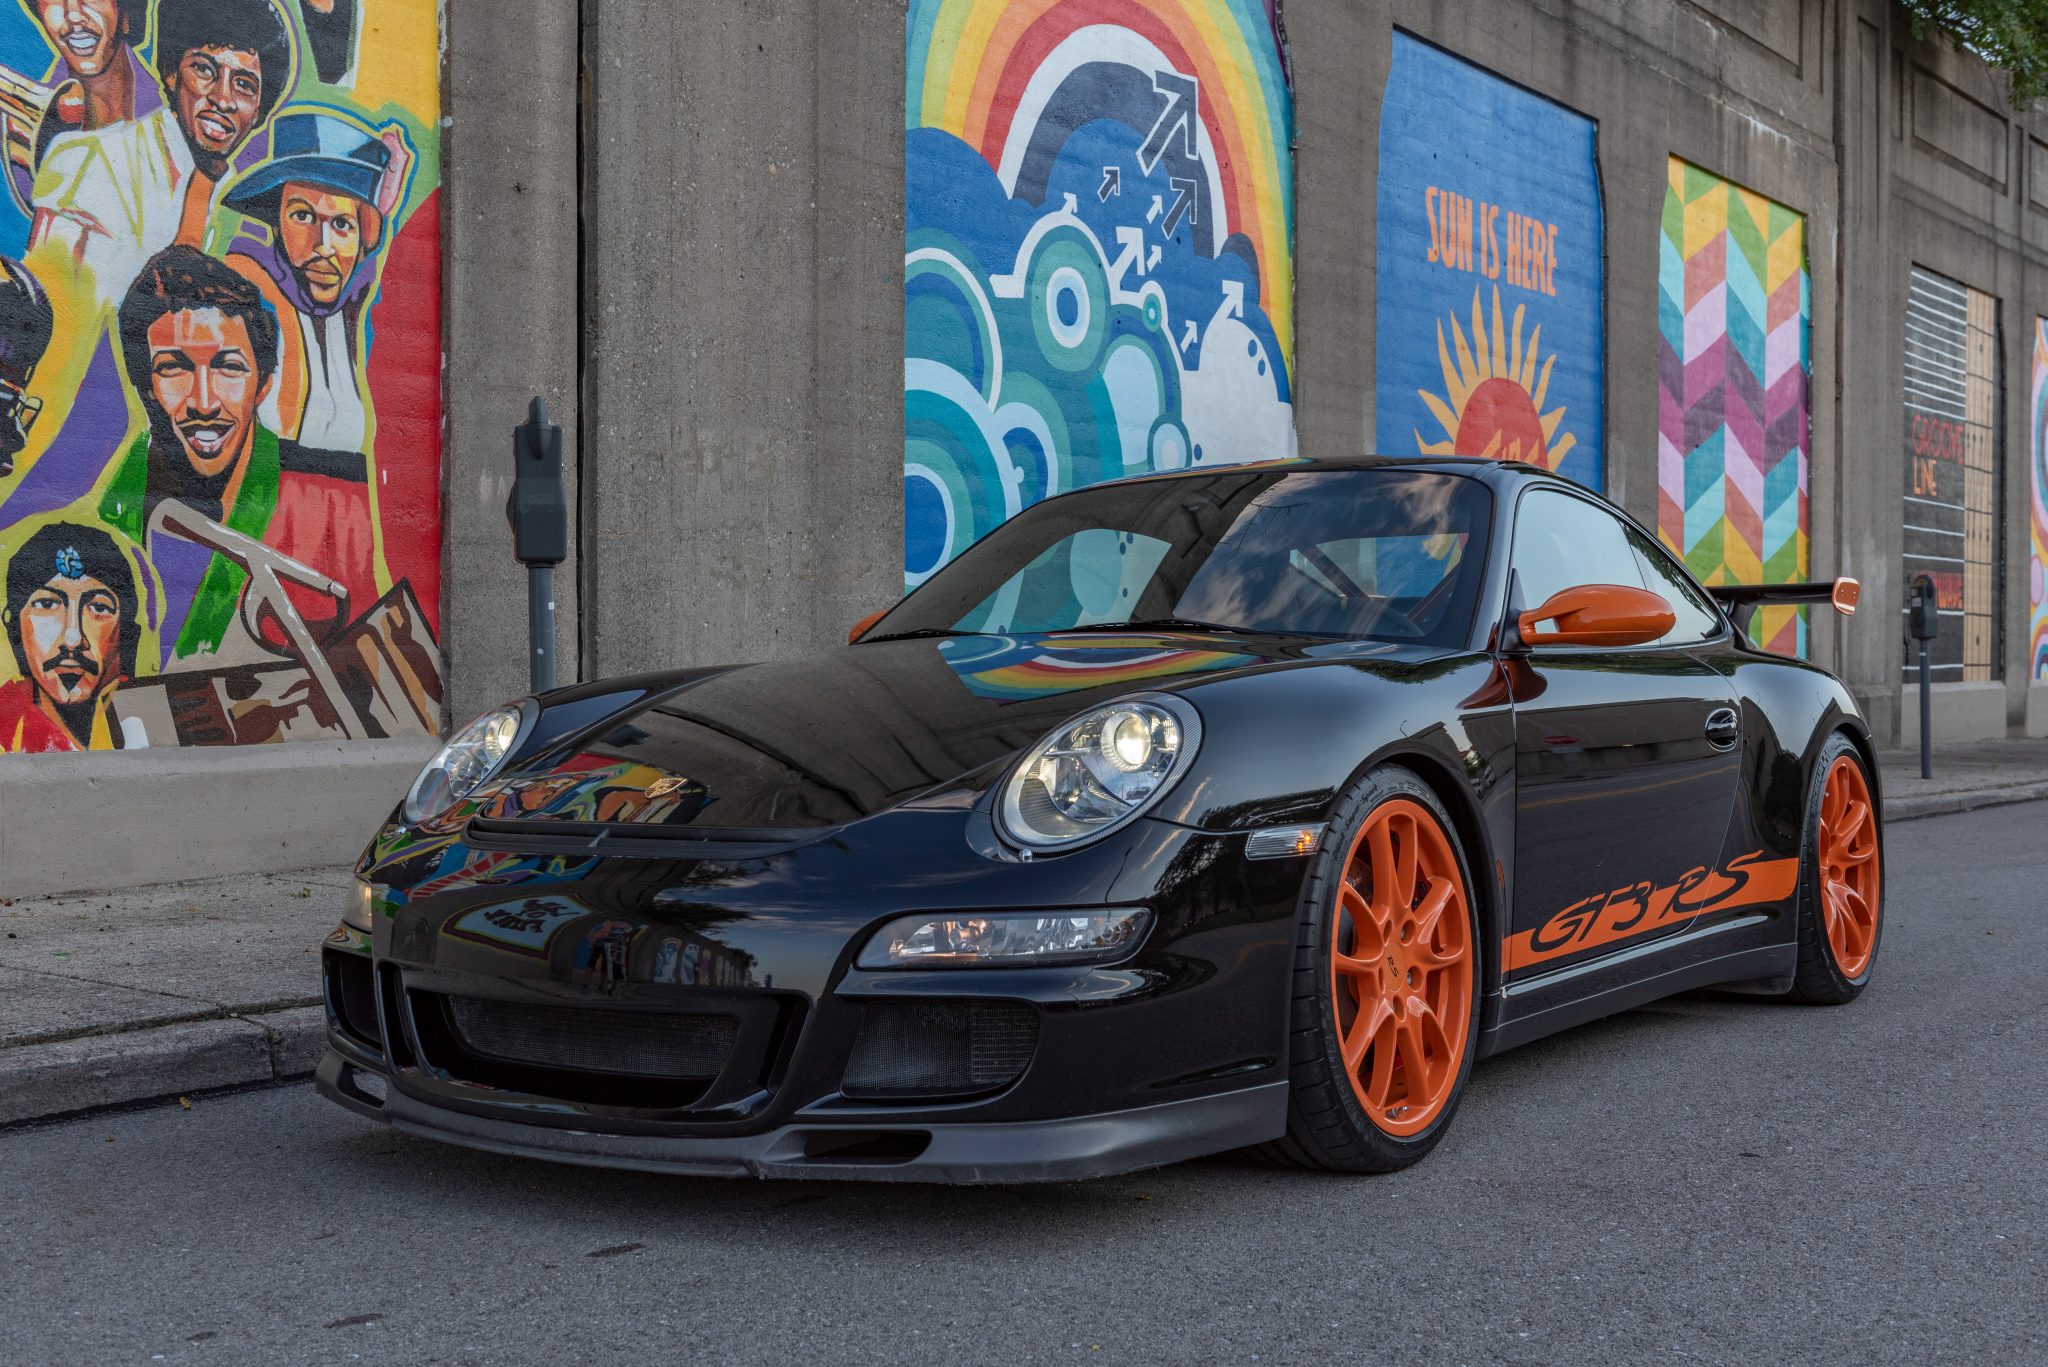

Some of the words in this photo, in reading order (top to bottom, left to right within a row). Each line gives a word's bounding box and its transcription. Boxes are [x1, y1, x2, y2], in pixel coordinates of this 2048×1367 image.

[1425, 186, 1473, 272] SUN
[1480, 202, 1500, 279] IS
[1507, 210, 1558, 297] HERE
[1911, 414, 1965, 465] GROOVE
[1913, 457, 1938, 497] LINE
[1361, 783, 1378, 804] Sport
[1530, 880, 1657, 952] GT3
[1659, 850, 1765, 920] RS
